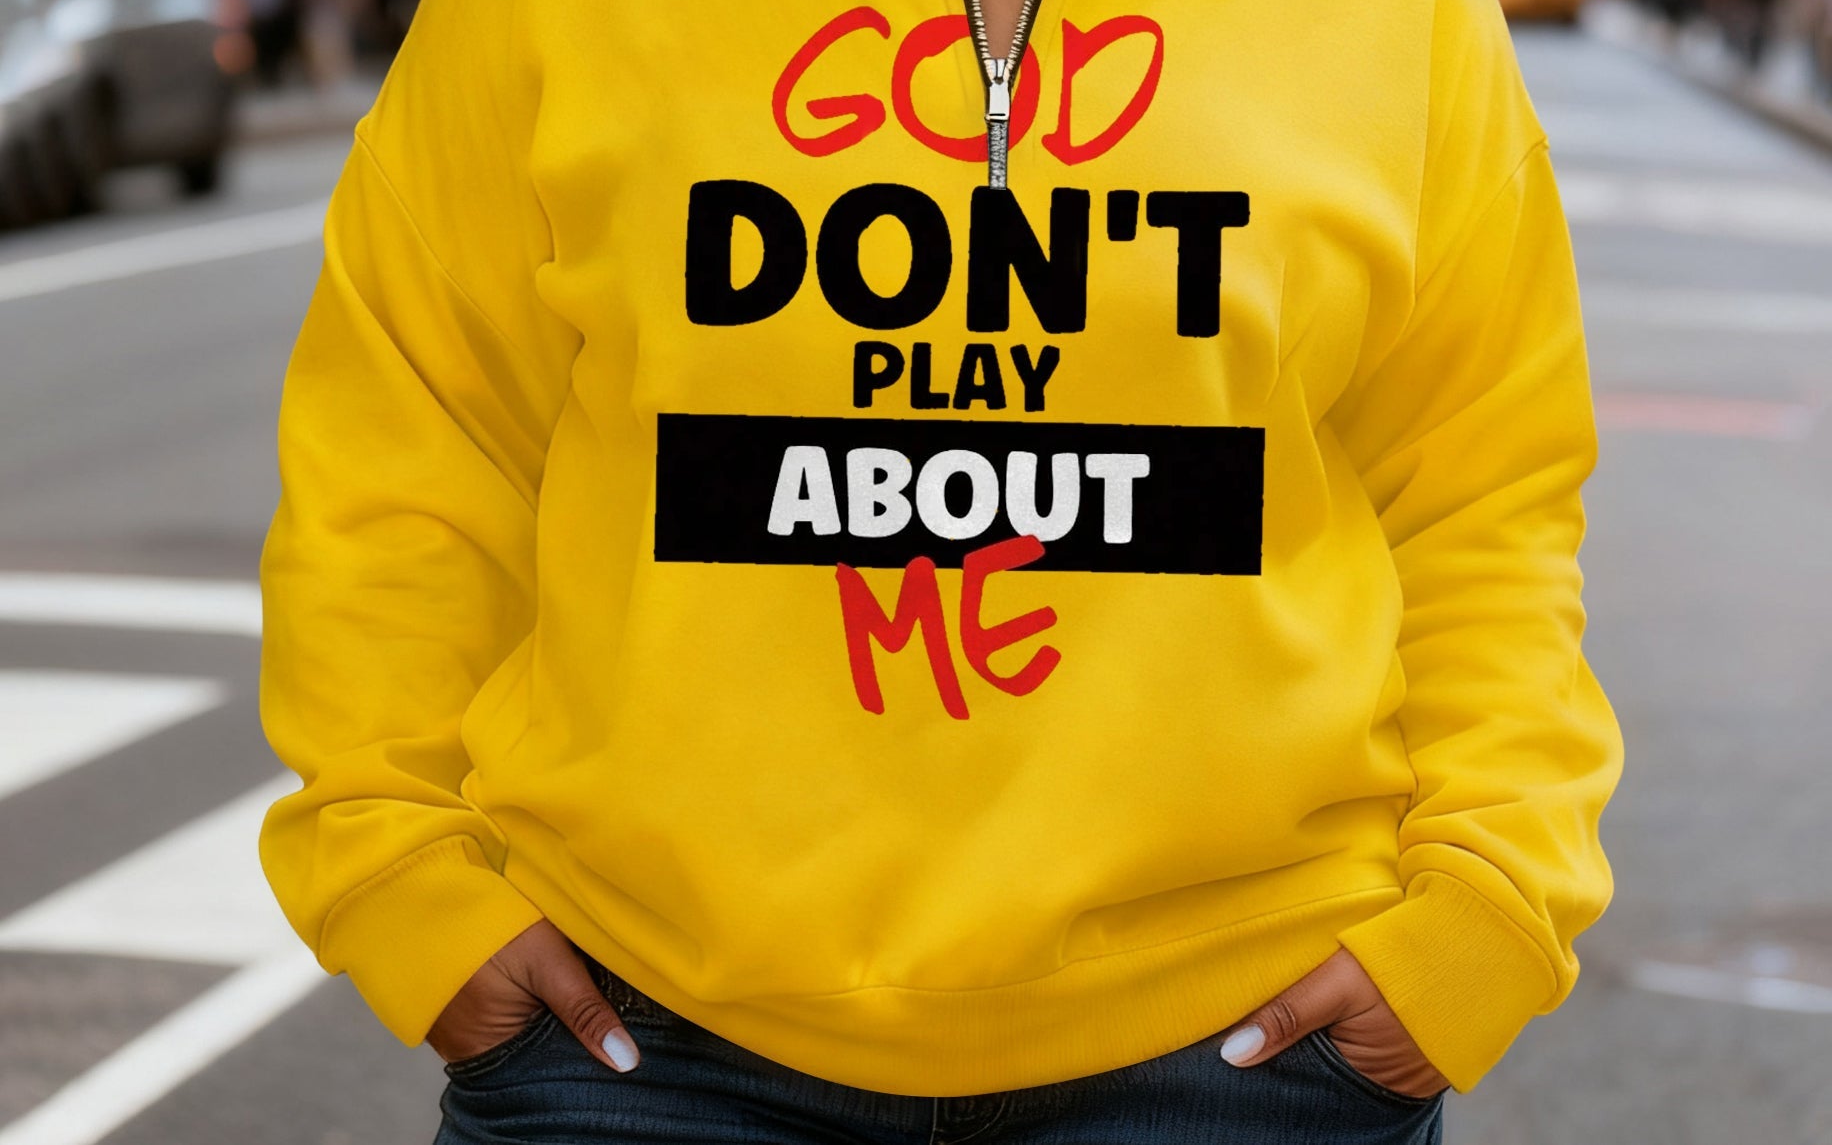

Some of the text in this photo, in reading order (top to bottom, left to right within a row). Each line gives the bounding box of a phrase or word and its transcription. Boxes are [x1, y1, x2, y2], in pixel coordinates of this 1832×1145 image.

[772, 6, 1164, 166] GOD
[685, 179, 1250, 337] DON'T
[852, 340, 1060, 412] PLAY
[767, 445, 1150, 544] ABOUT
[835, 535, 1062, 720] ME
